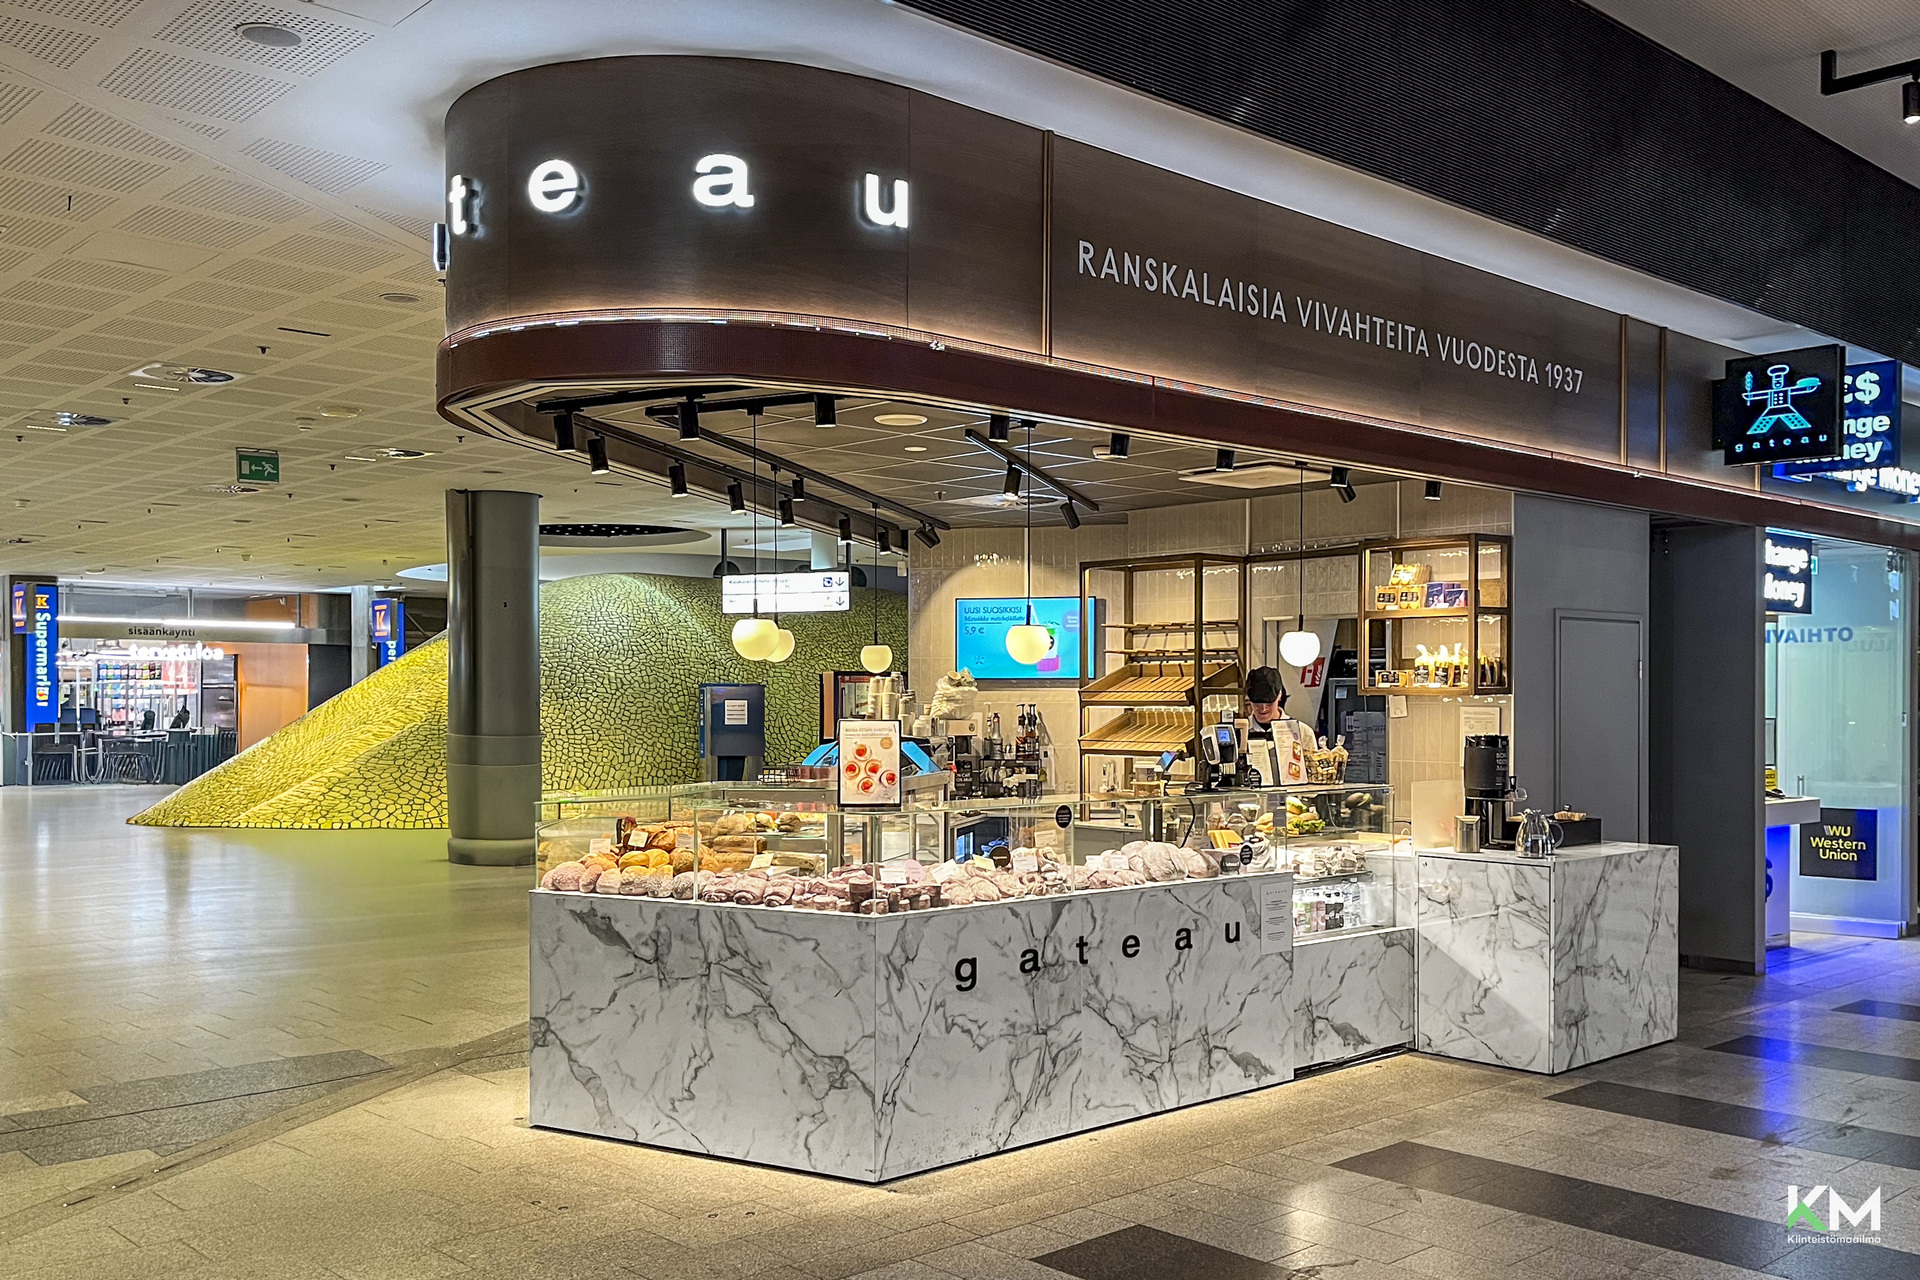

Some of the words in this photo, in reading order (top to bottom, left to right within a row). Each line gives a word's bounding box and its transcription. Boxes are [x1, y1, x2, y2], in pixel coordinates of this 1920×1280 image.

[434, 153, 909, 271] teau
[1078, 240, 1287, 323] RANSKALAISIA
[1297, 296, 1429, 358] VIVAHTEITA
[1437, 333, 1539, 385] VUODESTA
[1545, 362, 1583, 394] 1937
[1734, 433, 1828, 453] gateau
[964, 606, 980, 614] UUSI
[983, 606, 1022, 614] SUOSIKKISI
[1824, 825, 1852, 837] WU
[1809, 836, 1867, 850] Western
[1819, 848, 1858, 862] Union
[953, 920, 1241, 993] gateau
